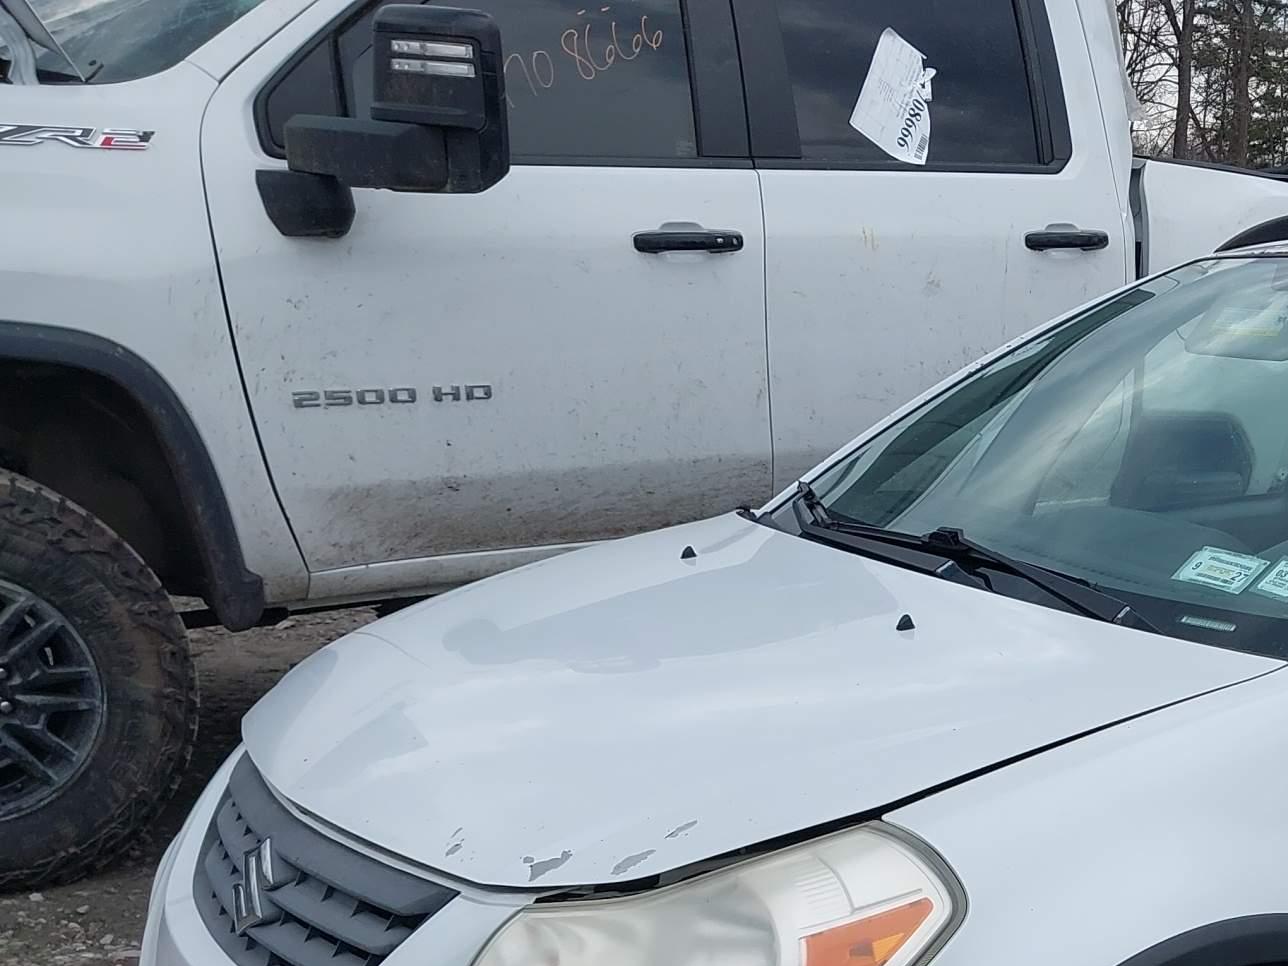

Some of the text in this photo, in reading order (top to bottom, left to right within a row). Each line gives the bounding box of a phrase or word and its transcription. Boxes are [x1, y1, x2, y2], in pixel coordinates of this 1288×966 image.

[503, 15, 663, 108] 708666
[292, 384, 492, 408] 2500 HD
